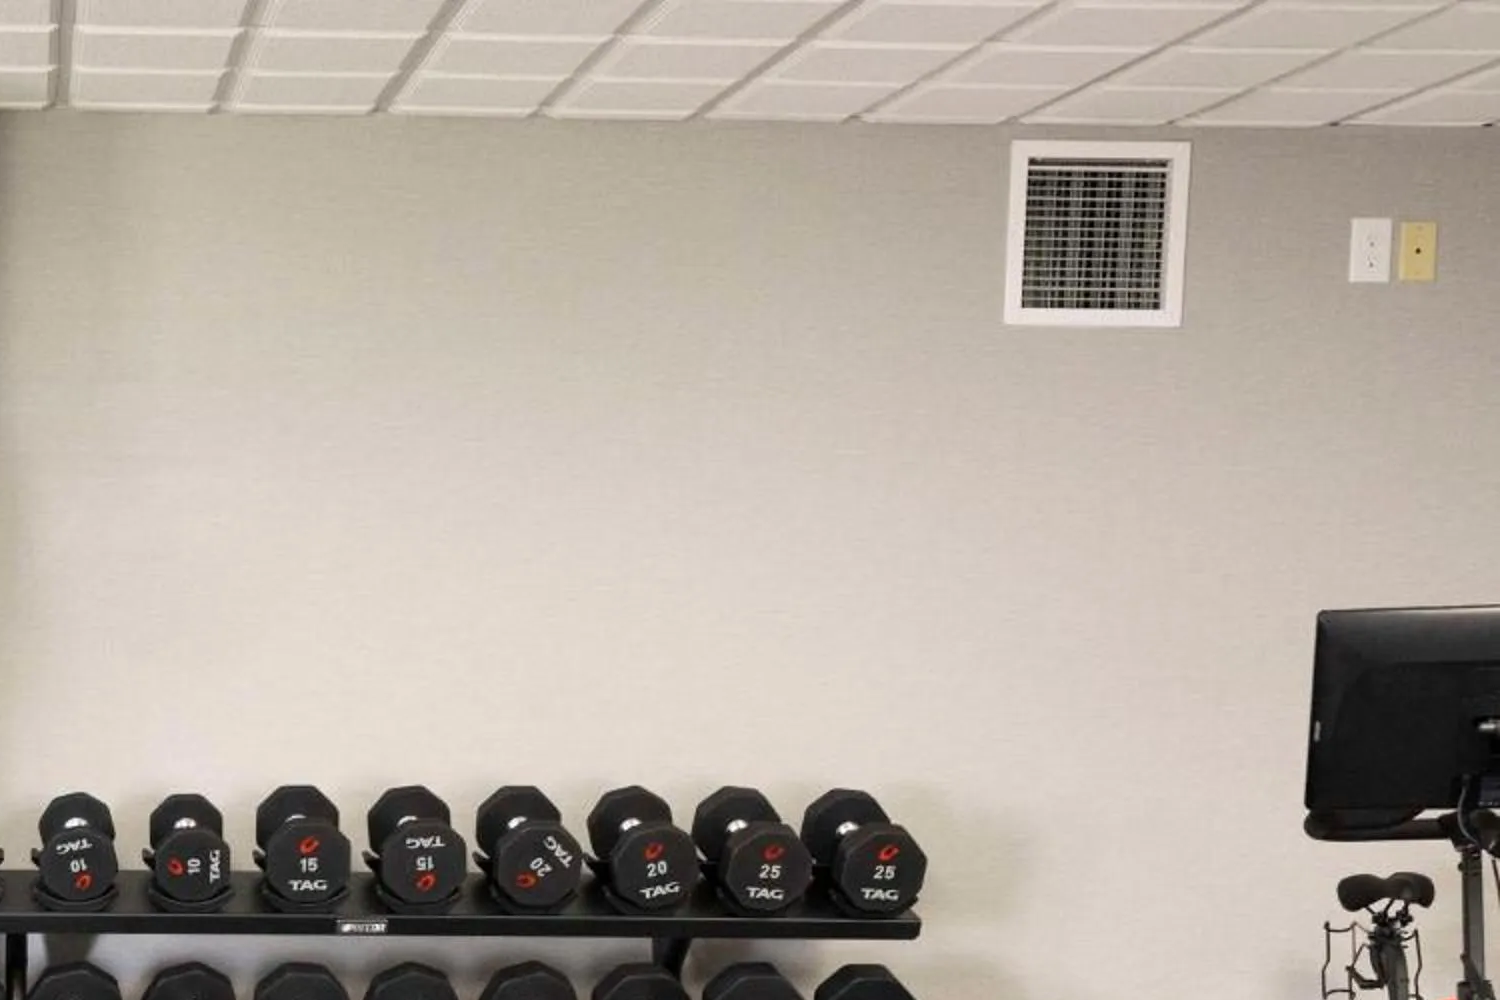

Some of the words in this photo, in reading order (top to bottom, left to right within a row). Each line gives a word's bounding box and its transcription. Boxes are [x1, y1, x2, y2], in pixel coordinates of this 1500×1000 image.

[55, 838, 93, 855] TAG
[405, 835, 446, 849] TAG
[543, 835, 573, 868] TAG
[69, 858, 88, 873] 10
[187, 857, 201, 875] 10
[209, 849, 221, 883] TAG
[299, 857, 319, 873] 15
[416, 855, 434, 871] 15
[529, 857, 553, 877] 20
[646, 860, 668, 878] 20
[758, 863, 782, 879] 25
[873, 864, 897, 881] 25
[288, 879, 328, 891] TAG
[639, 881, 681, 899] TAG
[746, 886, 784, 901] TAG
[861, 887, 899, 901] TAG
